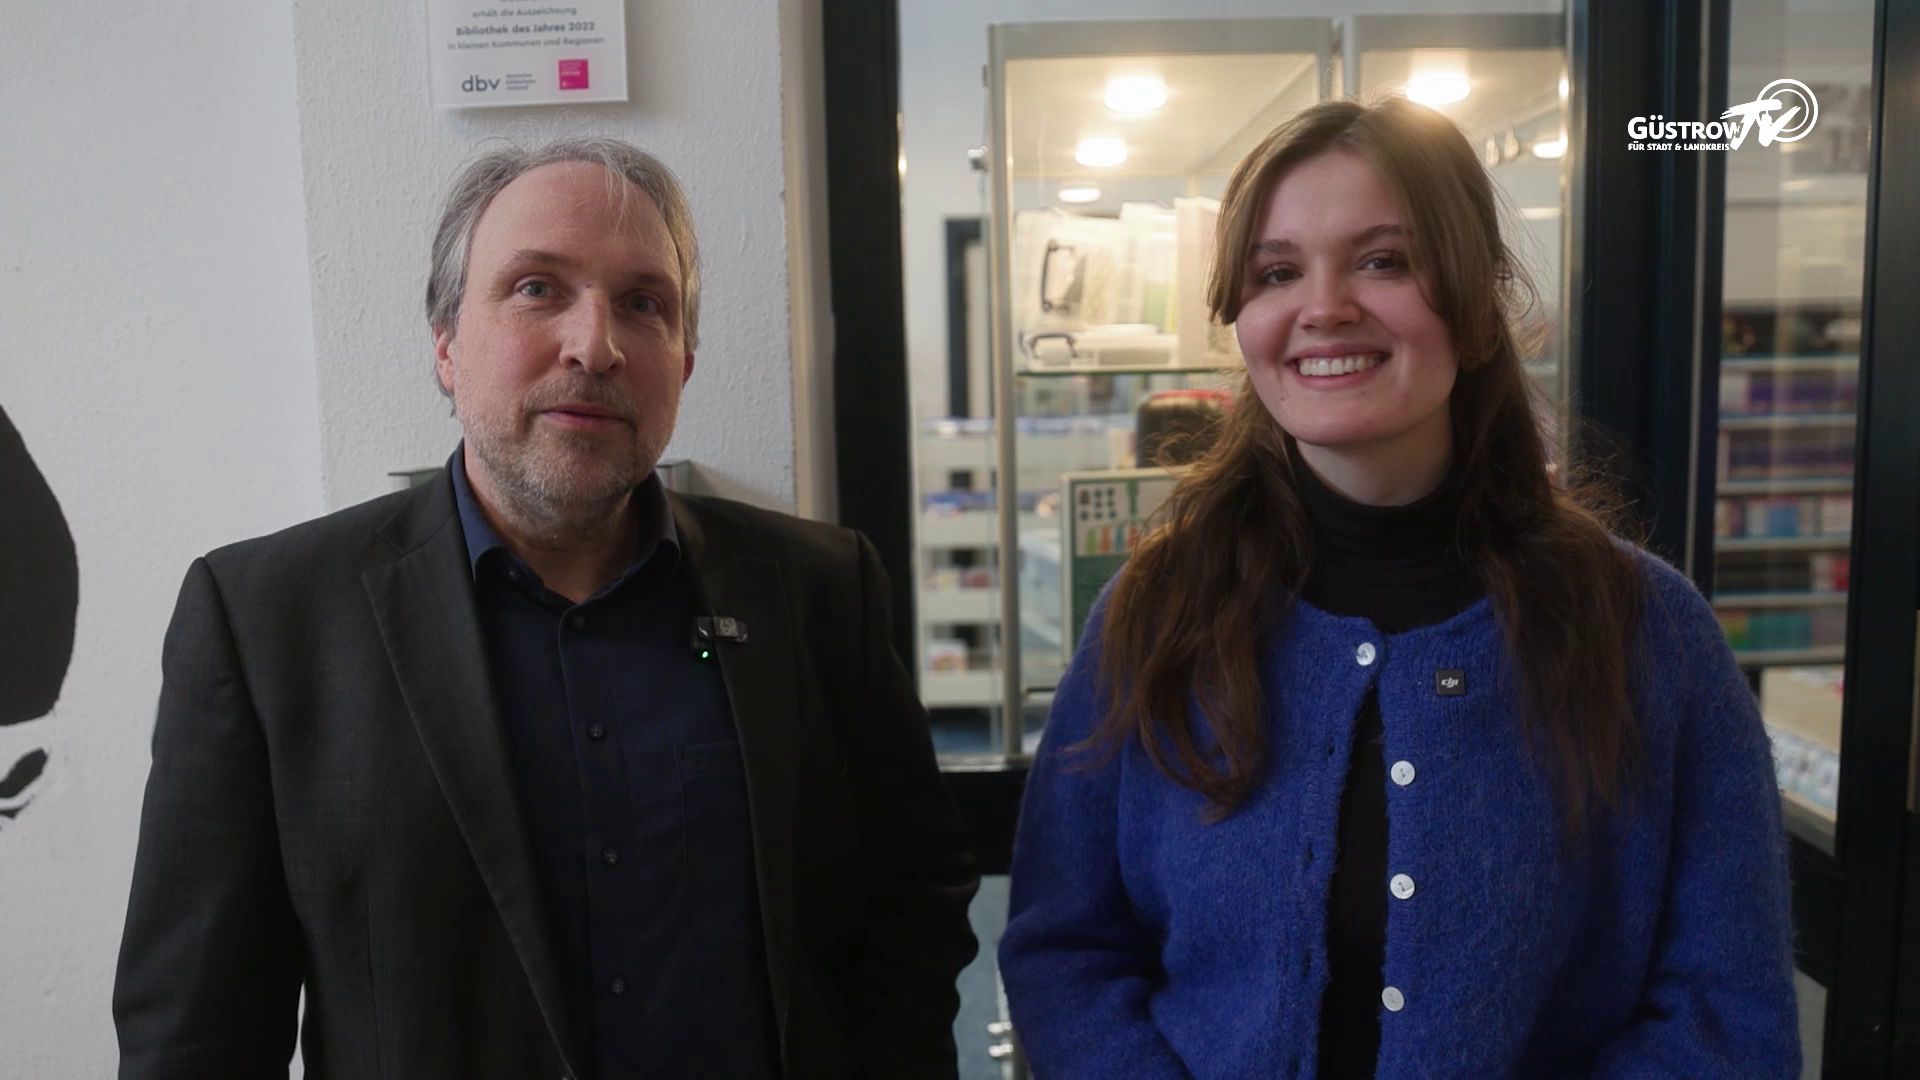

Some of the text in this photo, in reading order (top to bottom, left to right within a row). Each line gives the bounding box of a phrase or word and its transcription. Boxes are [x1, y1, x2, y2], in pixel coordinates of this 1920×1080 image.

[500, 8, 514, 17] die
[516, 6, 577, 16] Auszeichnung
[456, 21, 595, 36] Bibliothek des Jahres 2022
[543, 37, 561, 46] und
[461, 74, 500, 92] dbv
